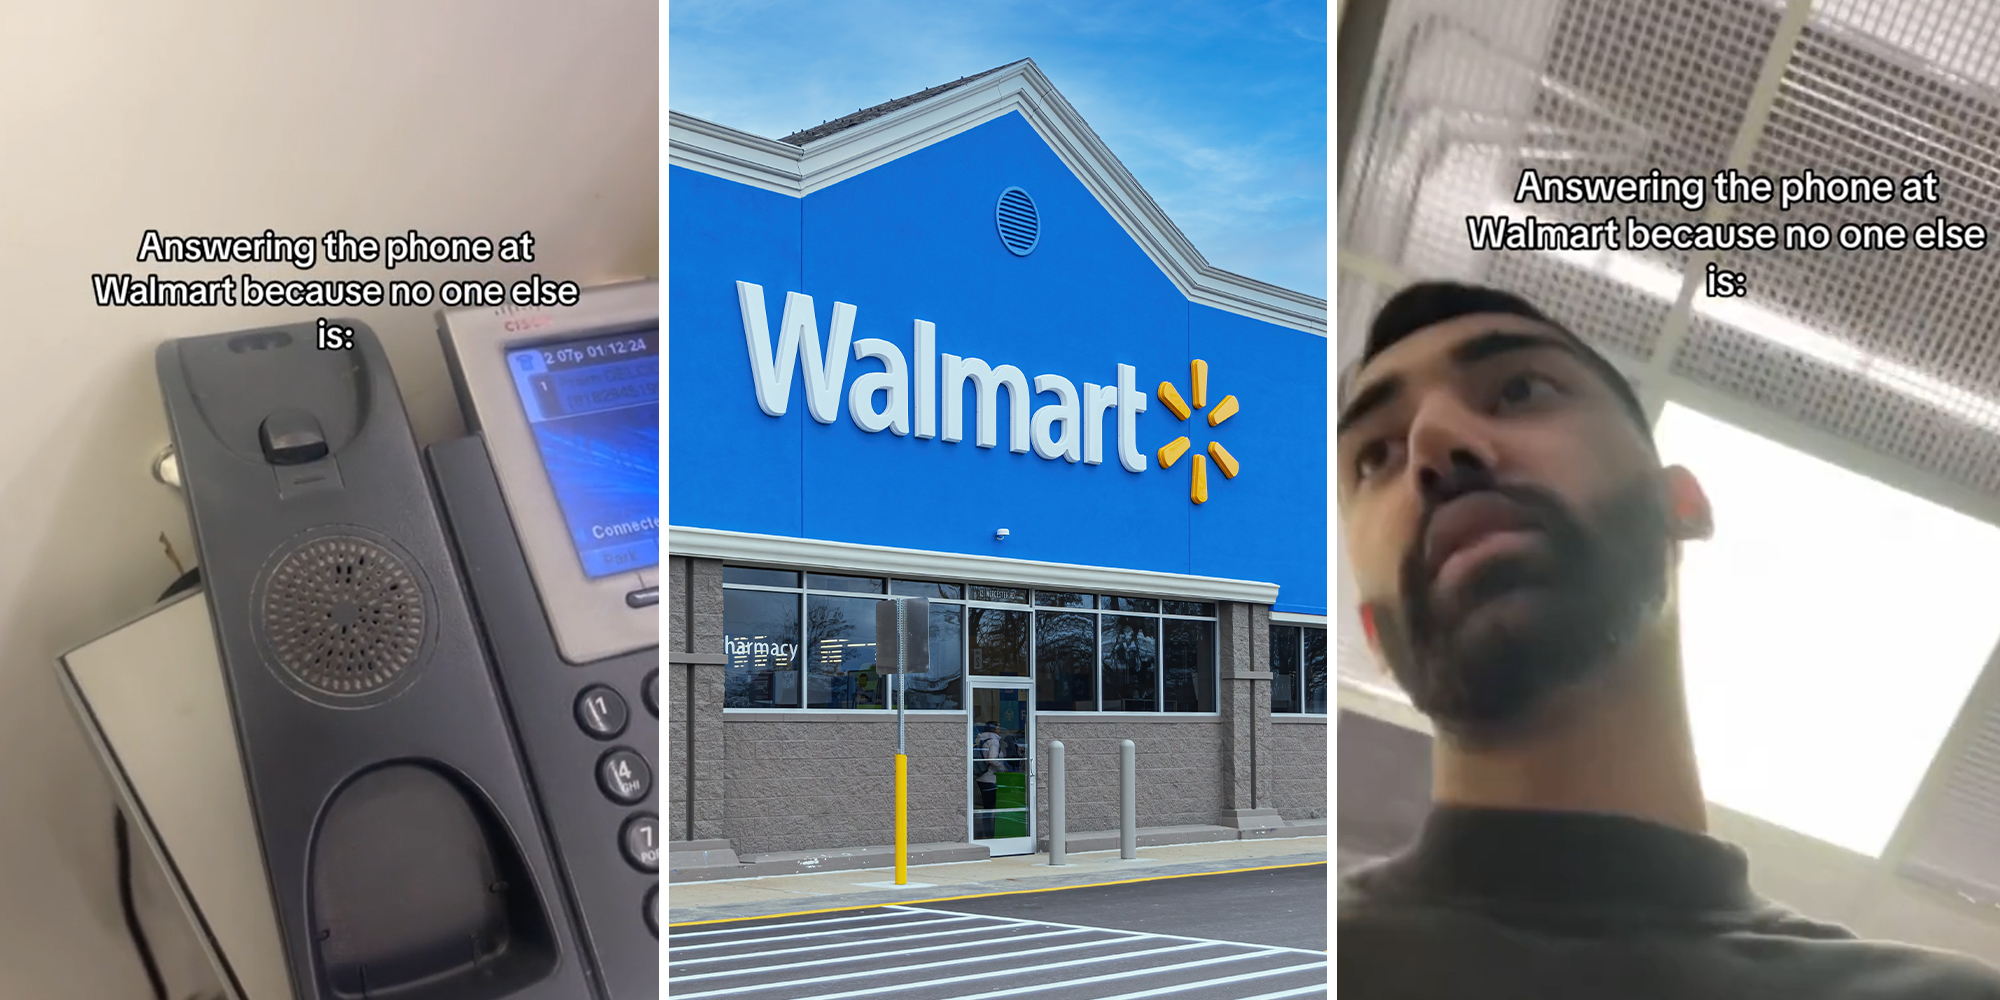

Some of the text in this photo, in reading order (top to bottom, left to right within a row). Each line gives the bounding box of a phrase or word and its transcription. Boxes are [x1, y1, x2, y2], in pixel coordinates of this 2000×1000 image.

[540, 381, 548, 391] 1
[736, 280, 1147, 473] Walmart
[595, 696, 607, 715] 1
[619, 760, 632, 779] 4
[620, 780, 640, 793] GHI
[640, 825, 652, 847] 7
